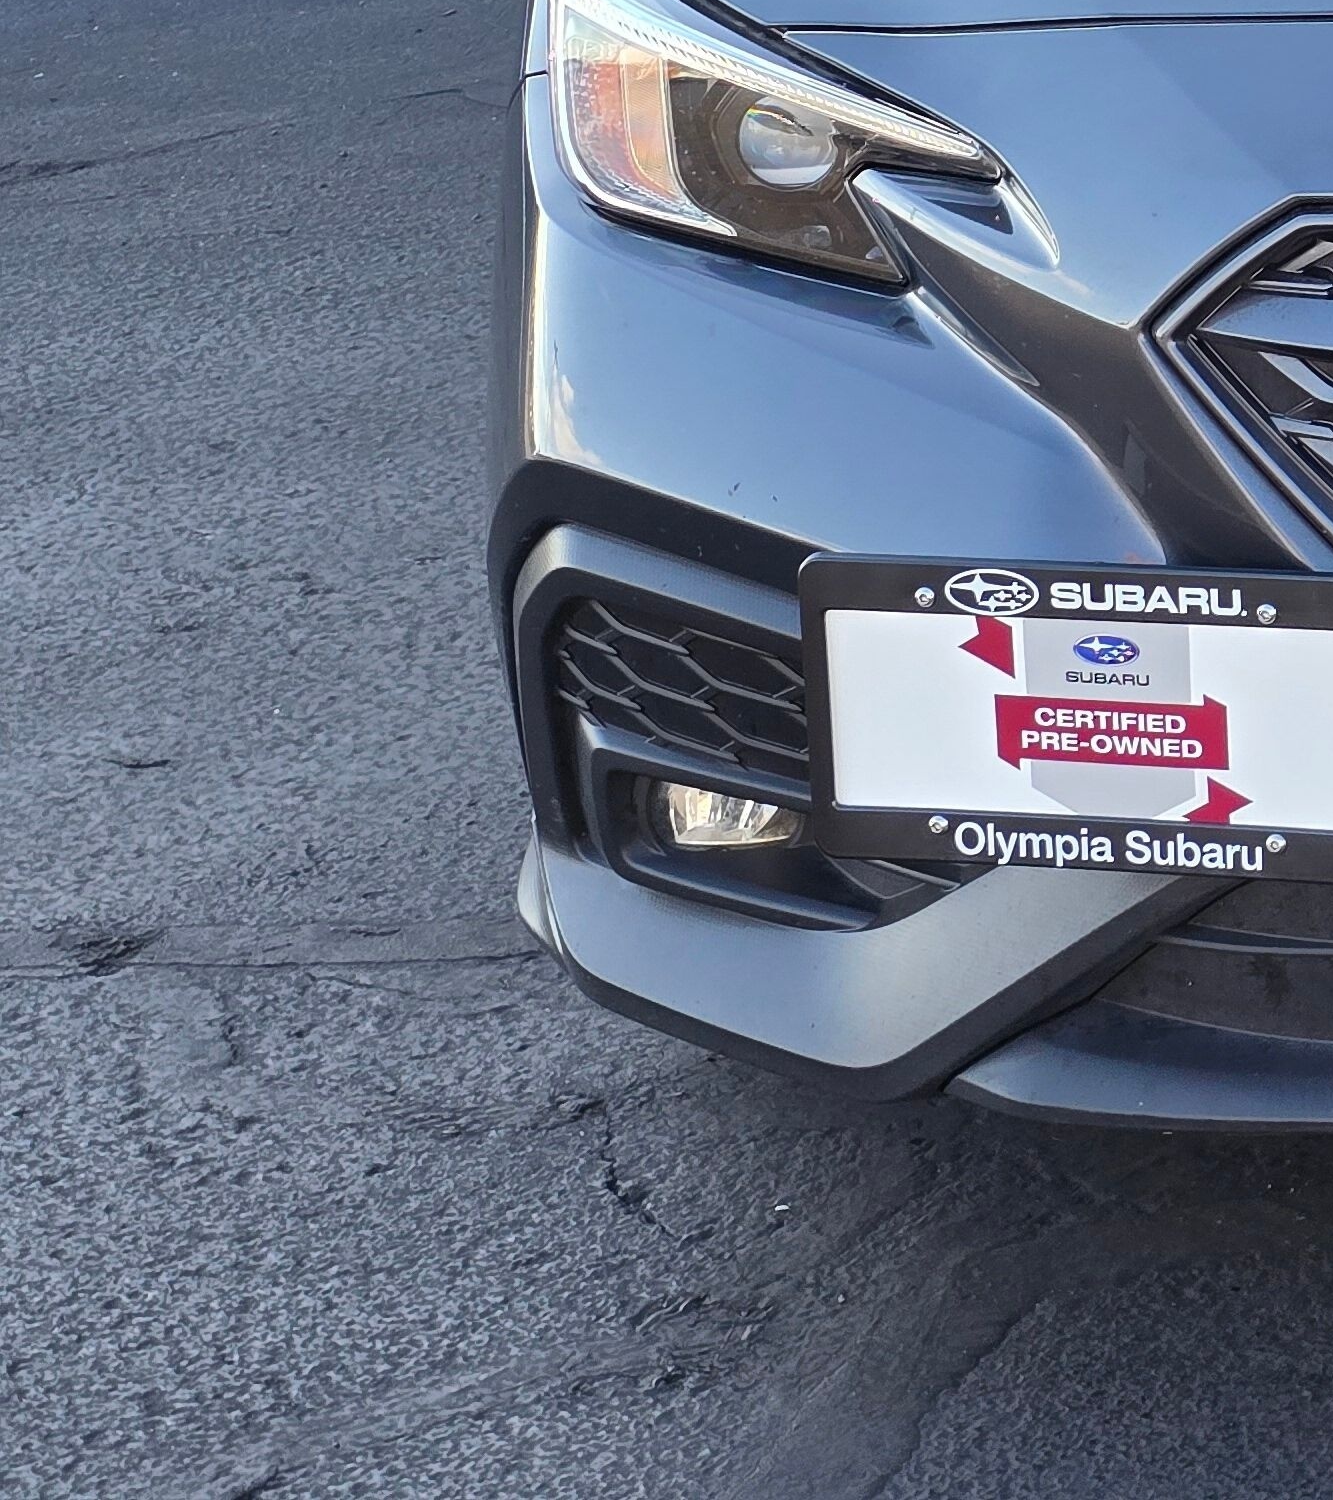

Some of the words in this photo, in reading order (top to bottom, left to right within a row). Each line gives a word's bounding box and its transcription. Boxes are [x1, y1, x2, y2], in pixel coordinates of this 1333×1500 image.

[1065, 670, 1150, 687] SUBARU
[1034, 707, 1187, 734] CERTIFIED
[1021, 729, 1203, 759] PRE-OWNED
[954, 821, 1114, 867] Olympia
[1125, 830, 1264, 871] Subaru
